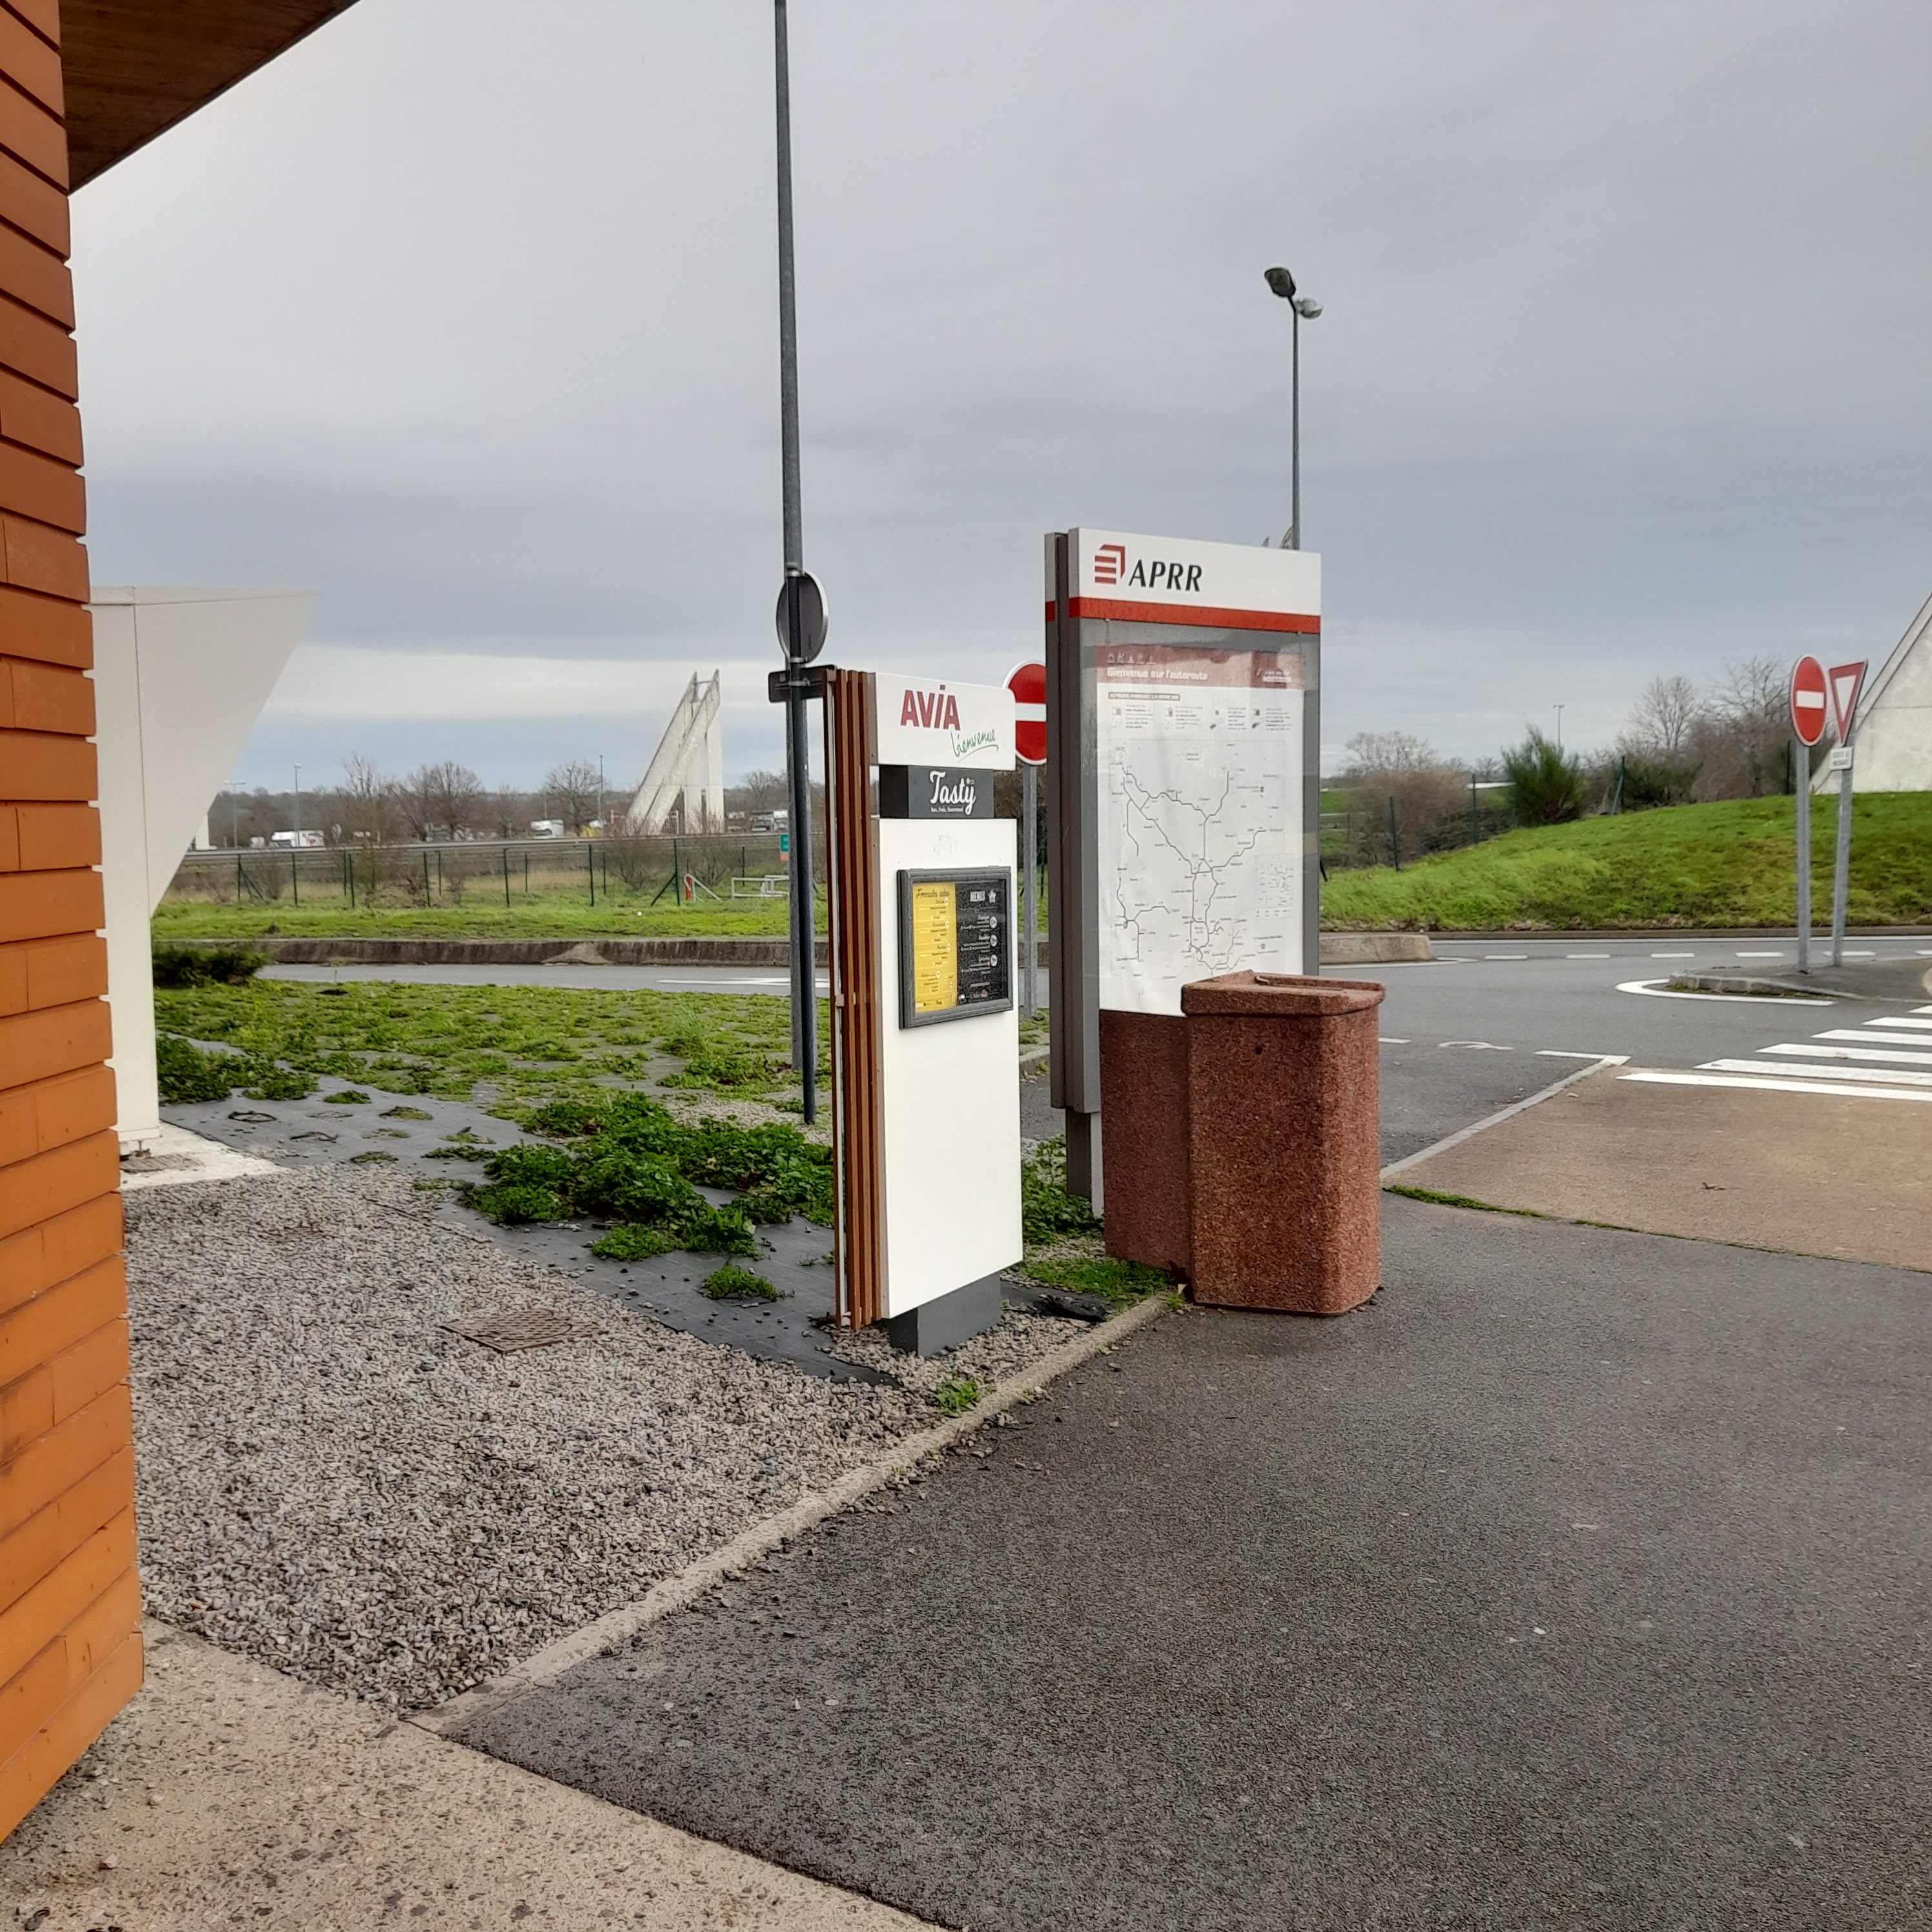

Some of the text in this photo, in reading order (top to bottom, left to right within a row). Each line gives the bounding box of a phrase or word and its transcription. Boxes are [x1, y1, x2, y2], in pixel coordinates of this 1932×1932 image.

[1128, 559, 1203, 592] APRR
[1107, 667, 1208, 681] Bienvenue sur l'autoroute
[900, 684, 961, 731] AVIA
[929, 770, 976, 816] Tasty
